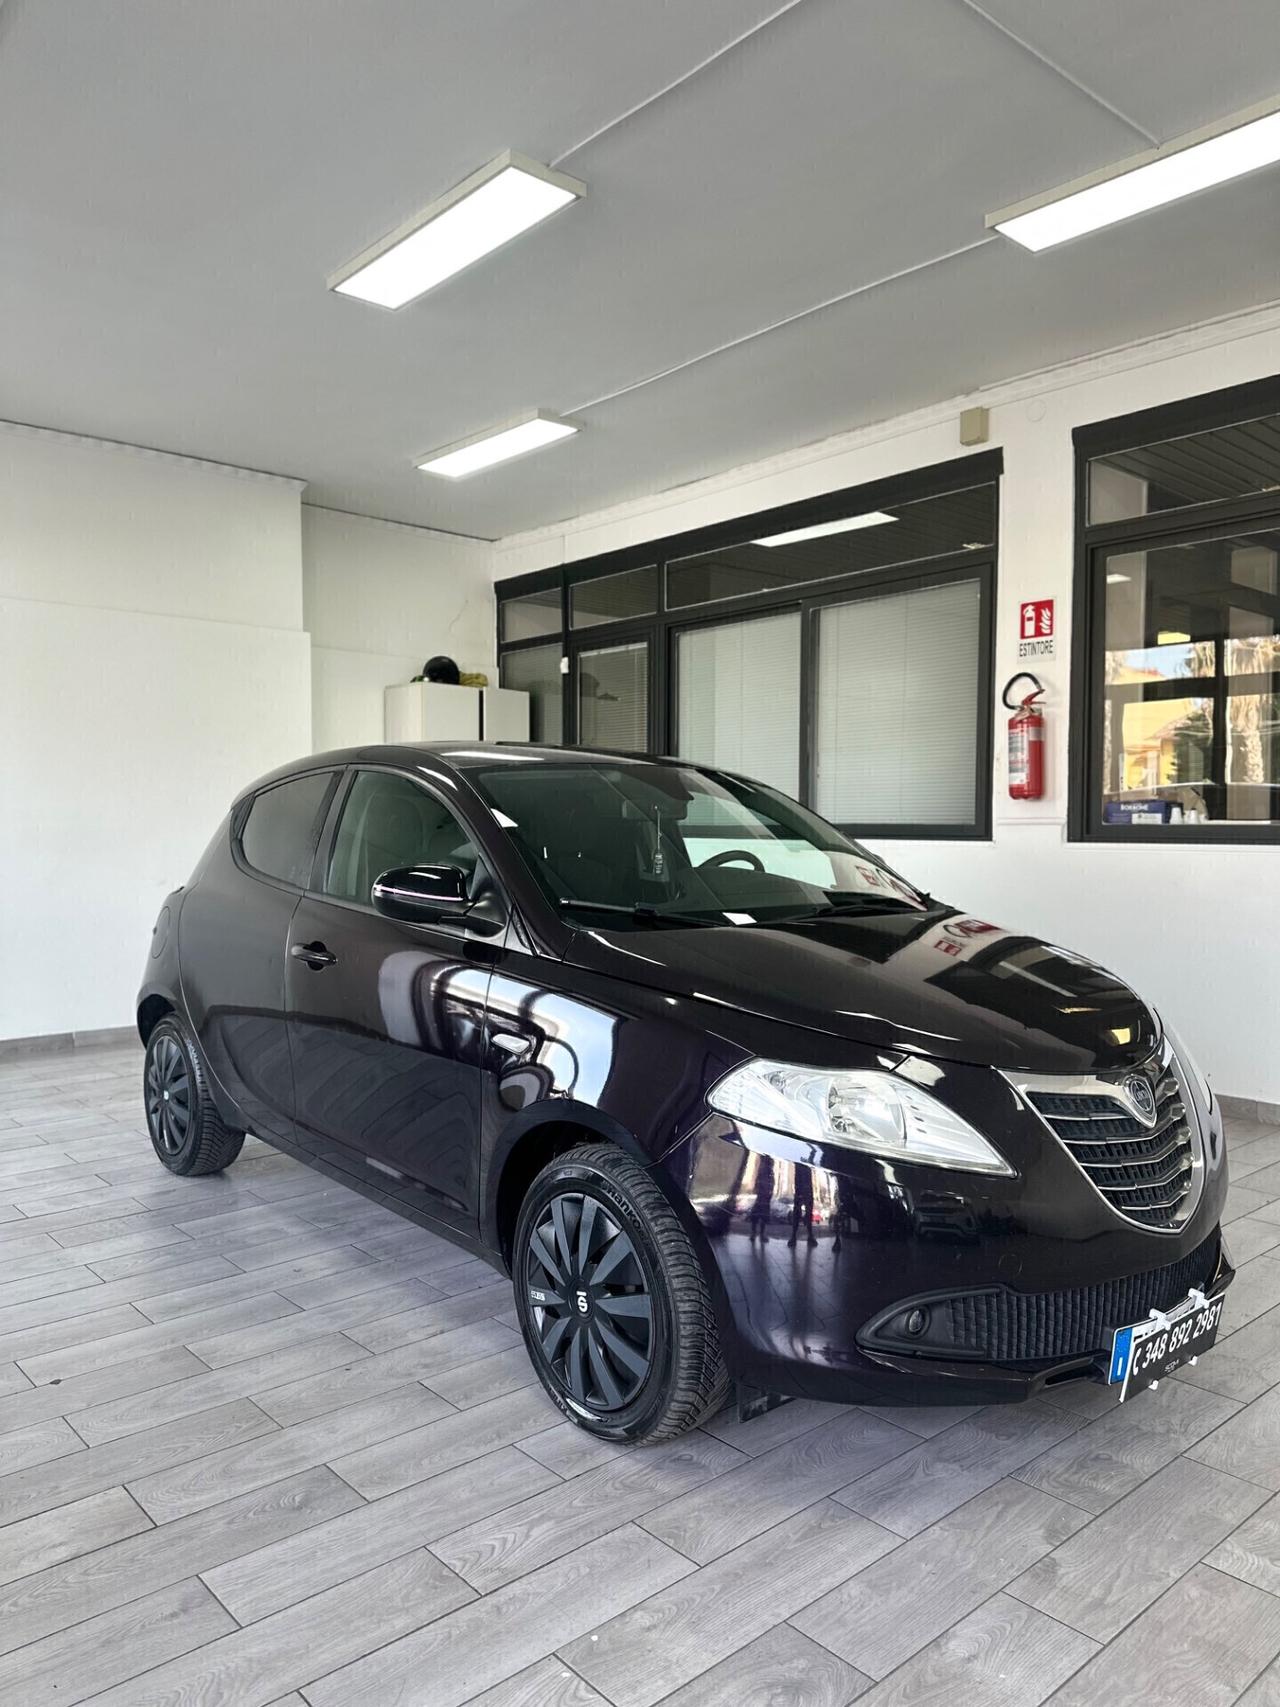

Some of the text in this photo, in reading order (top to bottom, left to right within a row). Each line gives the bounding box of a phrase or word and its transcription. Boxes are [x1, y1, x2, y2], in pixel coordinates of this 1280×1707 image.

[1019, 640, 1054, 657] ESTINTORE
[1142, 1333, 1168, 1369] 348
[1169, 1318, 1193, 1352] 892
[1192, 1302, 1222, 1339] 2981
